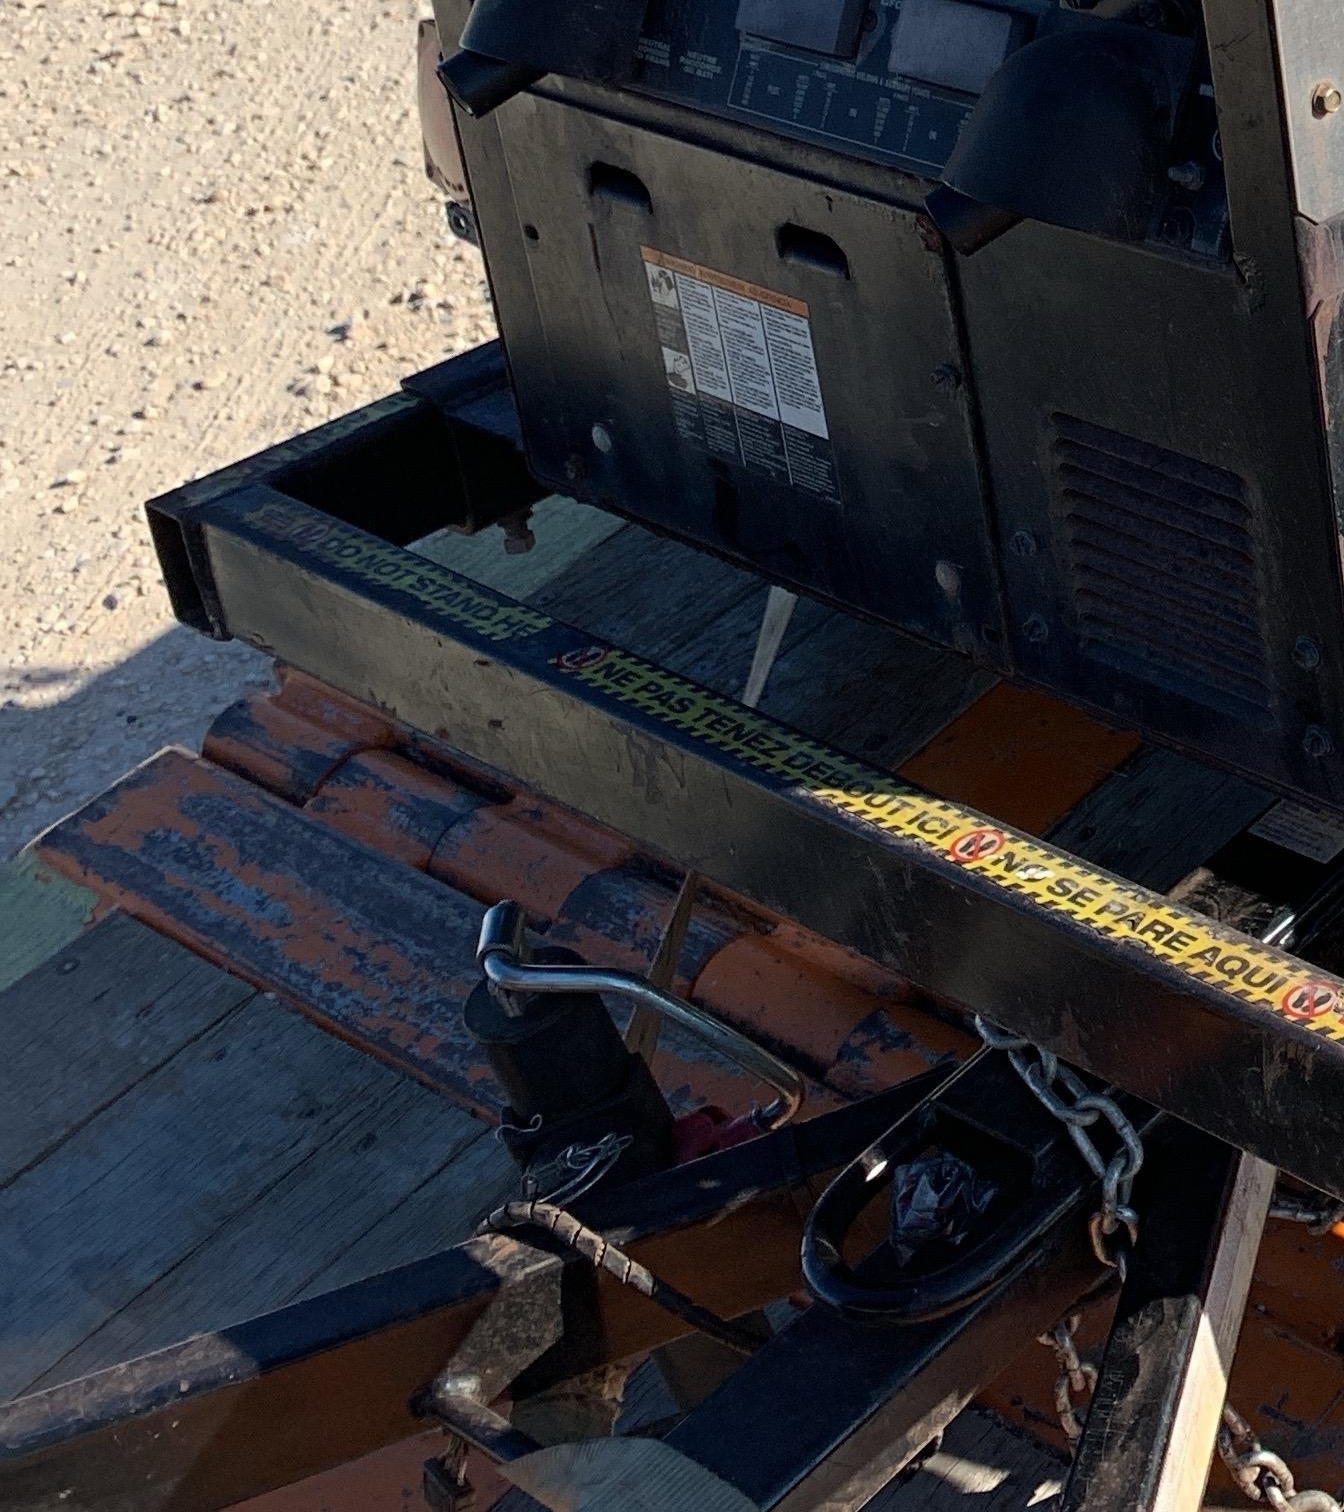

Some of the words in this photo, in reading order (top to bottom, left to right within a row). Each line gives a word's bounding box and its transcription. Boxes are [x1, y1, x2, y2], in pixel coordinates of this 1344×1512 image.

[322, 536, 361, 559] DO
[360, 552, 412, 581] NOT
[414, 574, 500, 623] STAND
[601, 662, 633, 688] NE
[633, 676, 696, 716] PAS
[691, 705, 789, 760] TENEZ
[781, 749, 916, 816] DEBOUT
[912, 810, 961, 841] ICI
[1046, 876, 1099, 909] SE
[1098, 899, 1199, 955] PARE
[1188, 945, 1291, 995] AQUI
